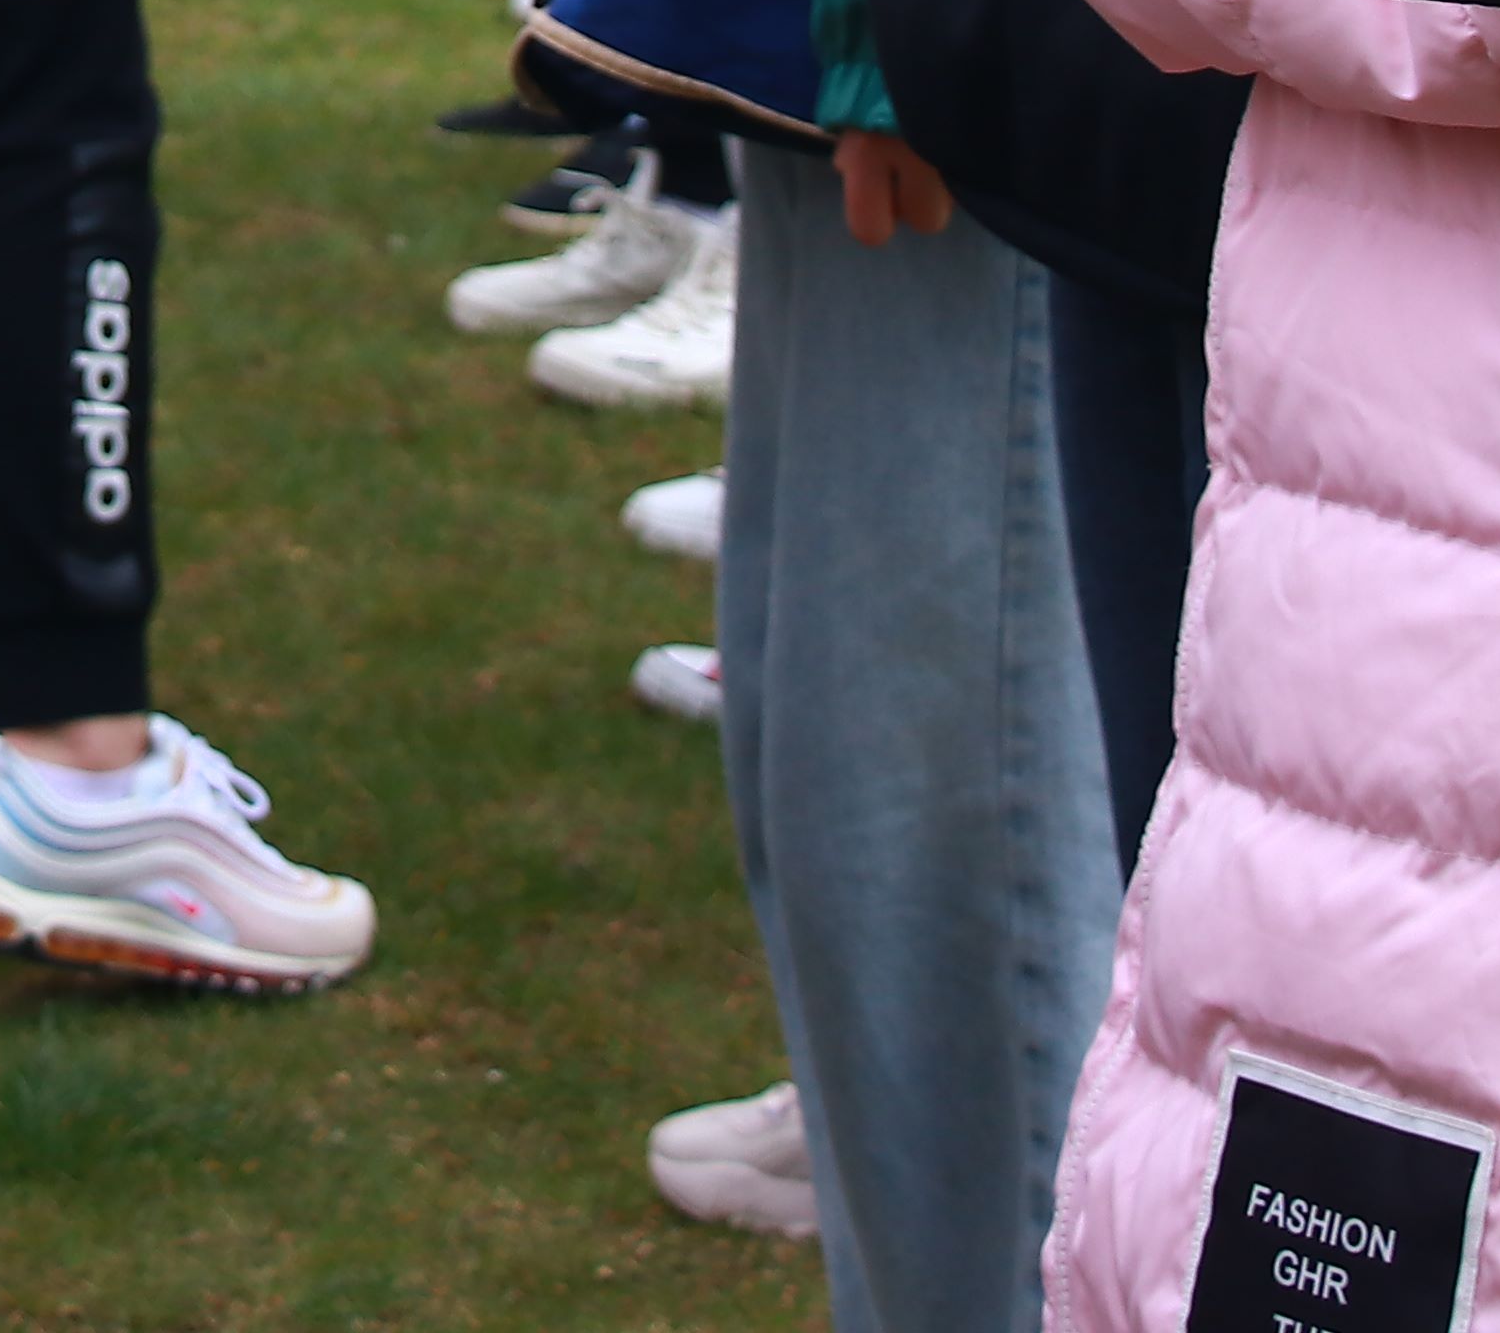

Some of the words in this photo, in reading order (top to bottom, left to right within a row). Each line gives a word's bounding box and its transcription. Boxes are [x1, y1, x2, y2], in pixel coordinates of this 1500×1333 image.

[71, 258, 131, 523] adidas
[1246, 1183, 1396, 1263] FASHION
[1273, 1249, 1349, 1305] GHR
